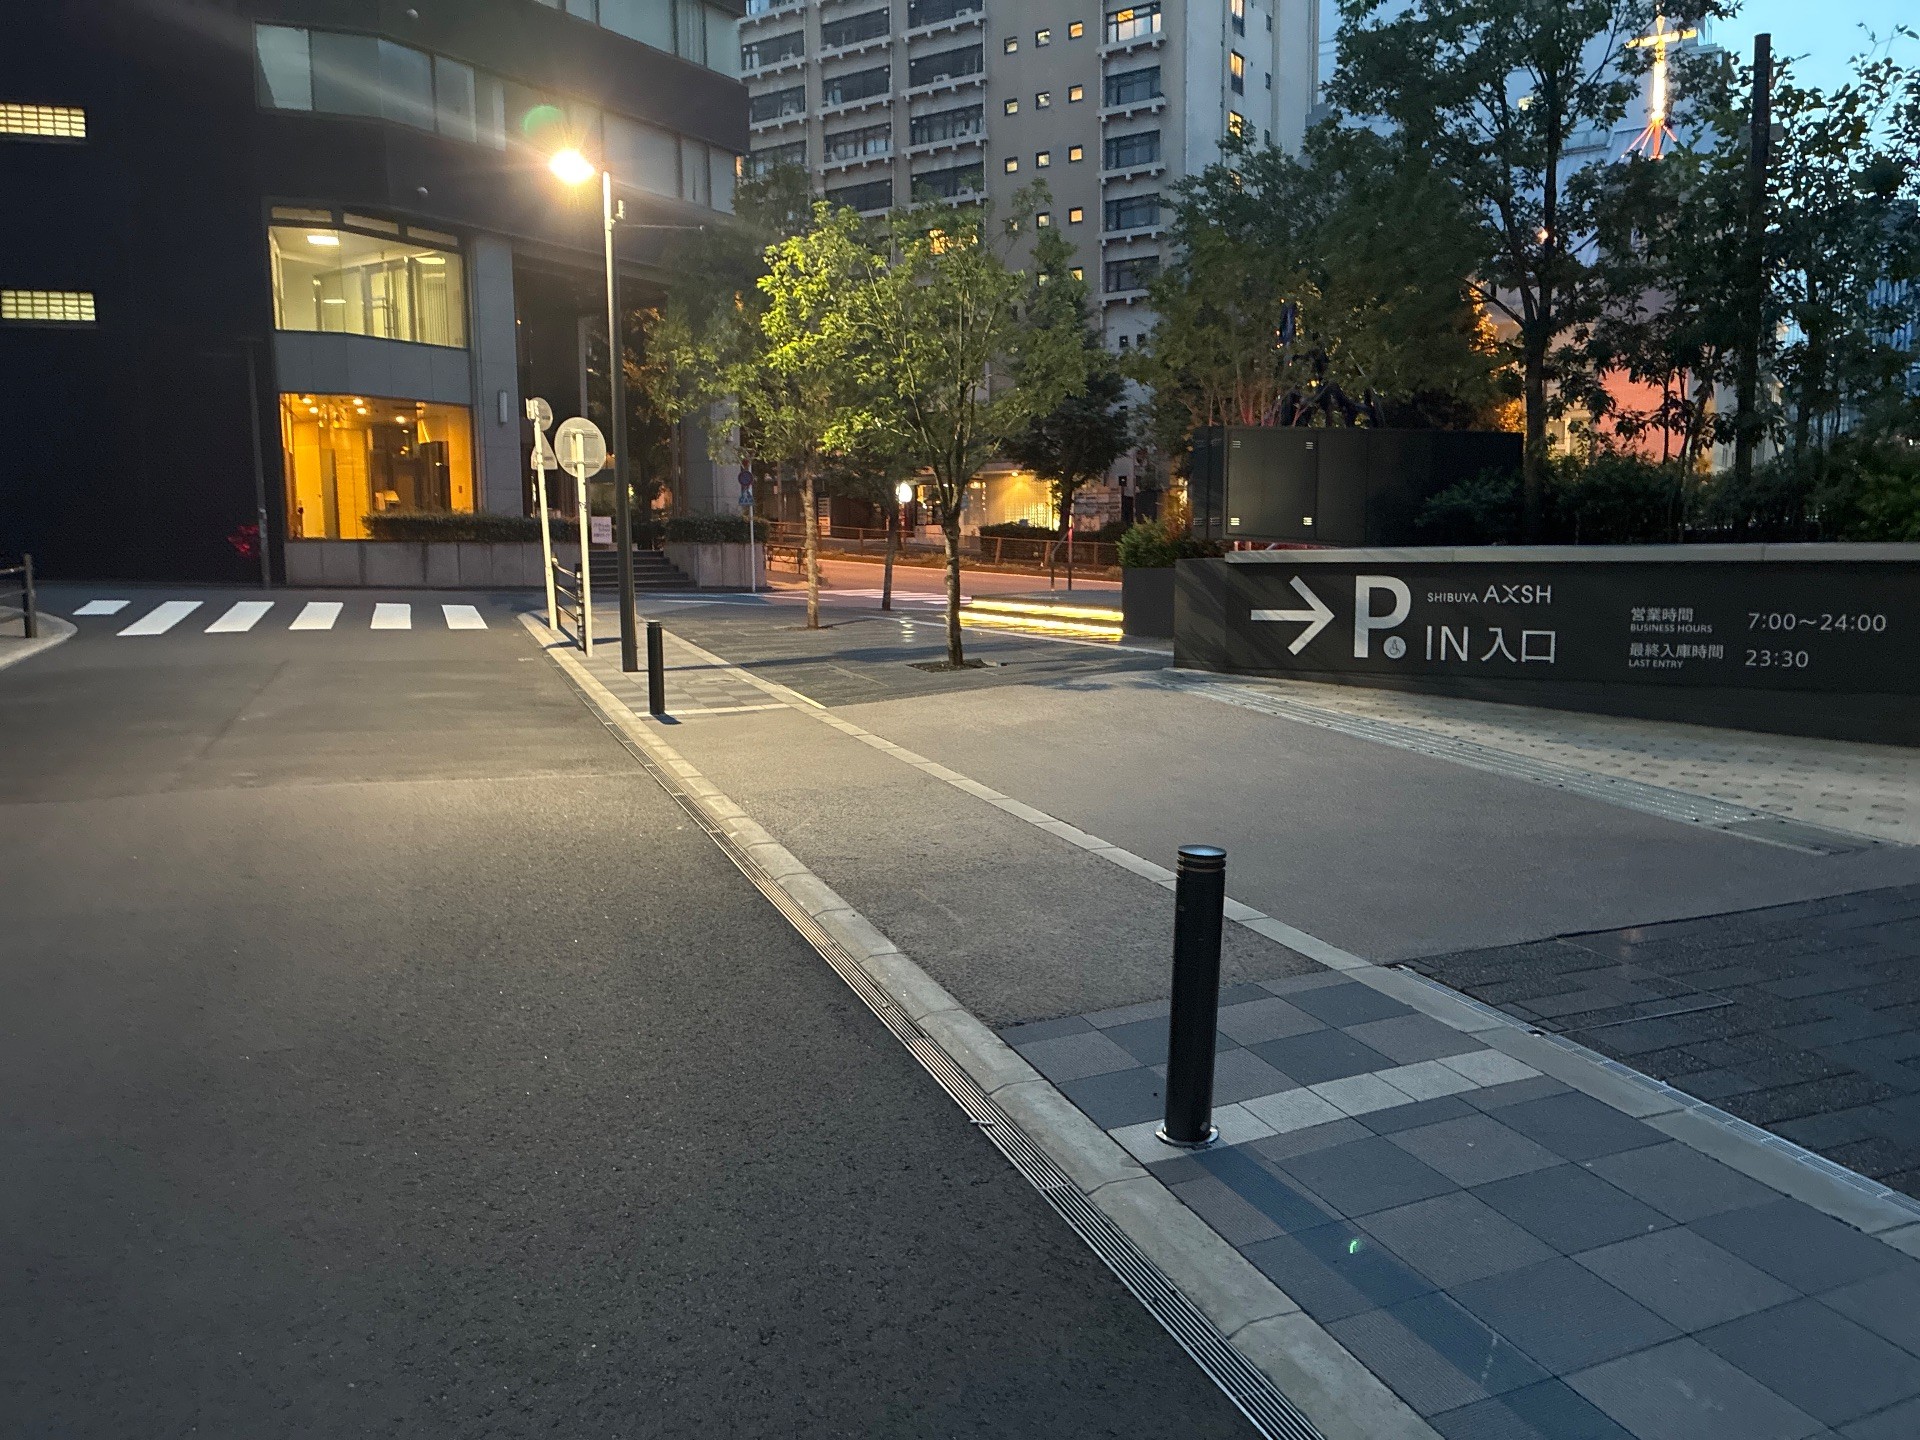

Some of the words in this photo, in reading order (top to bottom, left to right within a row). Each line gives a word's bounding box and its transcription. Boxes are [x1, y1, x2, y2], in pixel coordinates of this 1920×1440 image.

[1427, 592, 1479, 603] SHIBUYA
[1483, 584, 1552, 604] AXSH
[1631, 607, 1693, 622] 営業時間
[1630, 623, 1675, 633] BUSINESS
[1677, 624, 1713, 633] HOURS
[1426, 625, 1469, 662] IN
[1480, 627, 1556, 664] 入口
[1628, 659, 1650, 667] LAST
[1652, 659, 1684, 668] ENTRY
[1630, 642, 1724, 659] 最終入庫時間
[1745, 650, 1809, 668] 23:30
